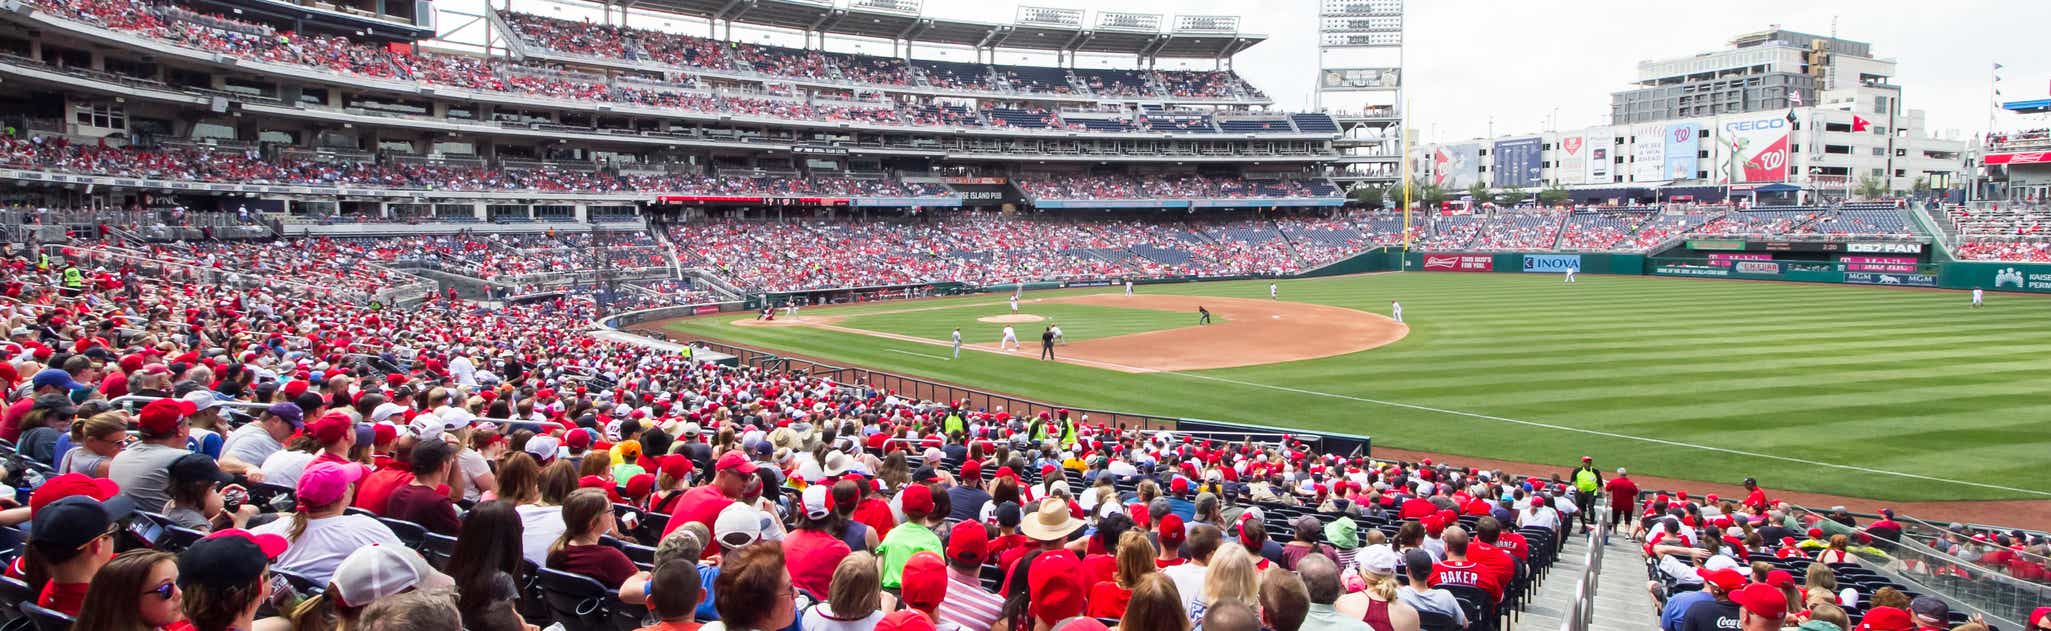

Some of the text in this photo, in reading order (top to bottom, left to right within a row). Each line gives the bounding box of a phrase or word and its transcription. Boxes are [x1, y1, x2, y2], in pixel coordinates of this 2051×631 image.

[1726, 118, 1784, 132] GEICO
[155, 194, 180, 206] PNC
[970, 192, 990, 200] ISLAND
[990, 192, 1002, 200] PUB
[1885, 243, 1922, 253] FAN
[1537, 258, 1579, 268] INOVA
[1440, 571, 1478, 584] BAKER
